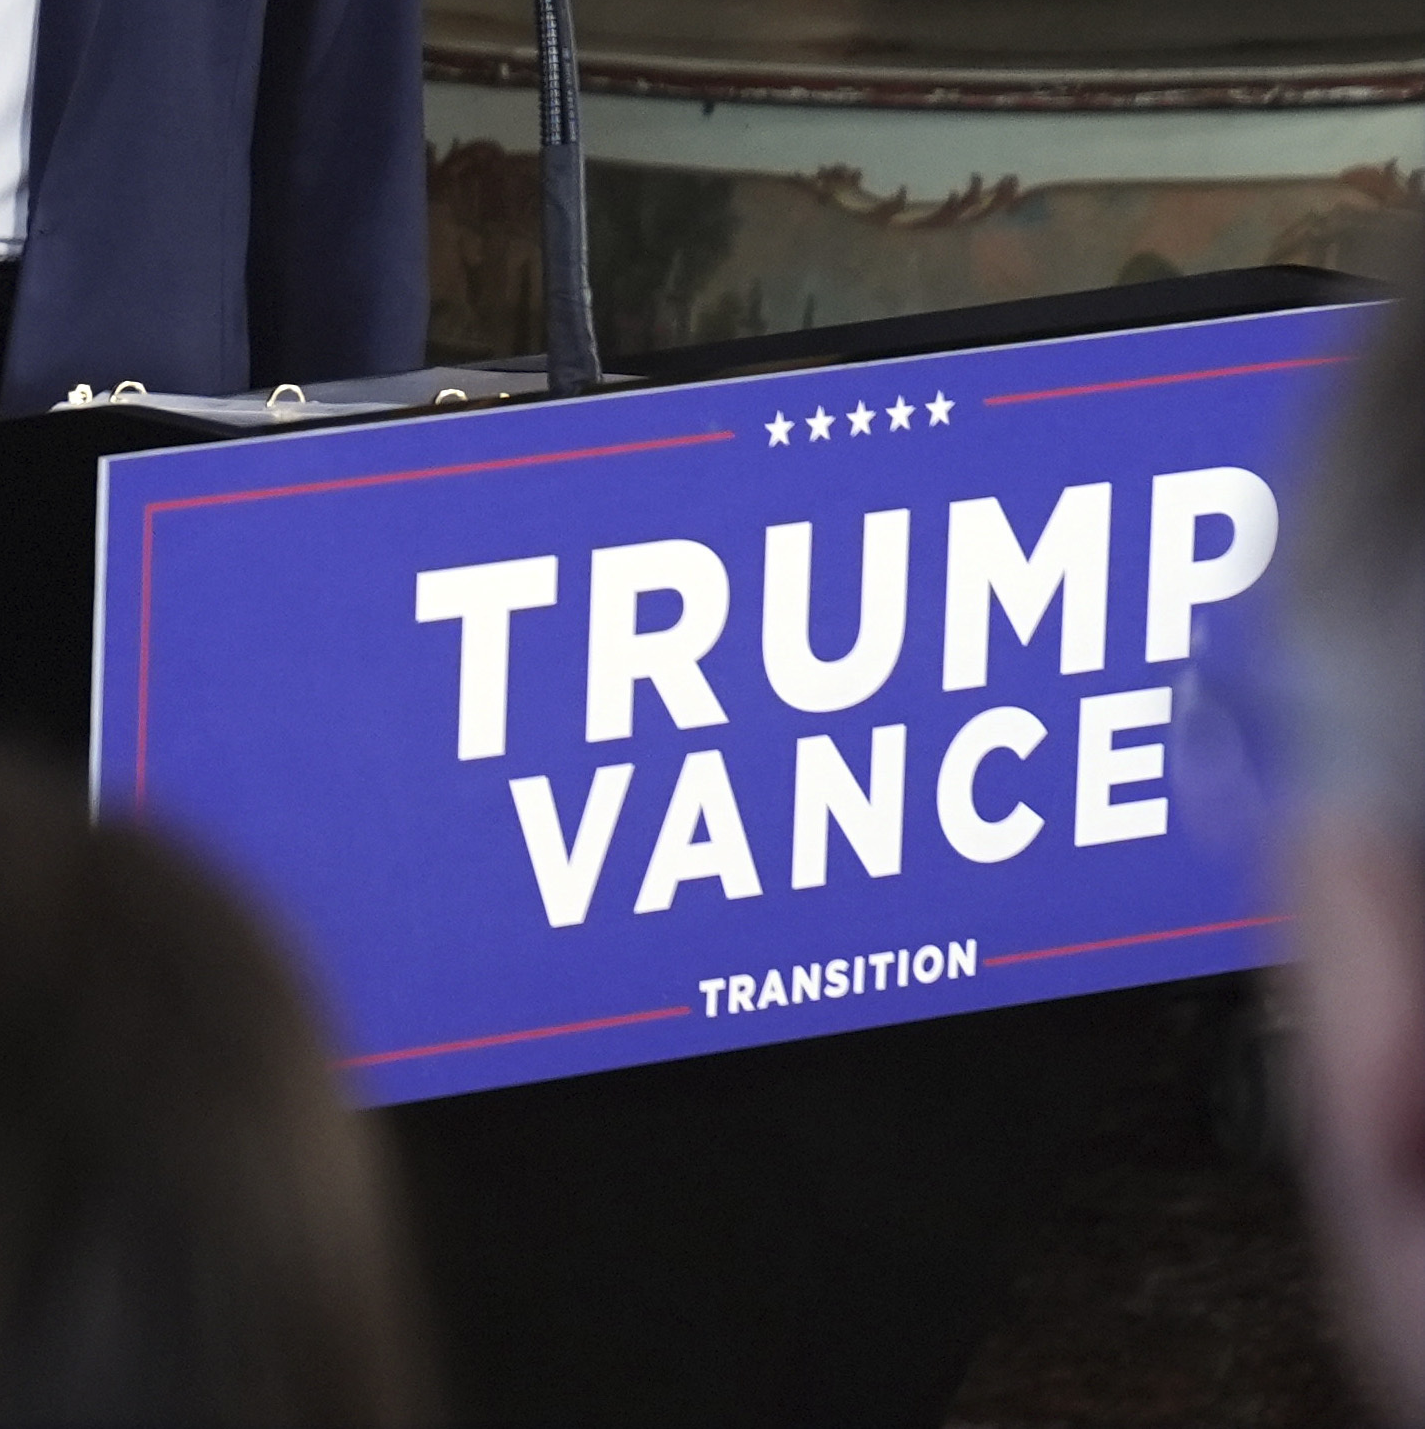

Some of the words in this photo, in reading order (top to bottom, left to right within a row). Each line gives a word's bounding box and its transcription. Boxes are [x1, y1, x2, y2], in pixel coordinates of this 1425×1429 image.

[415, 465, 1280, 762] TRUMP
[508, 686, 1173, 928] VANCE
[698, 937, 978, 1018] TRANSITION
